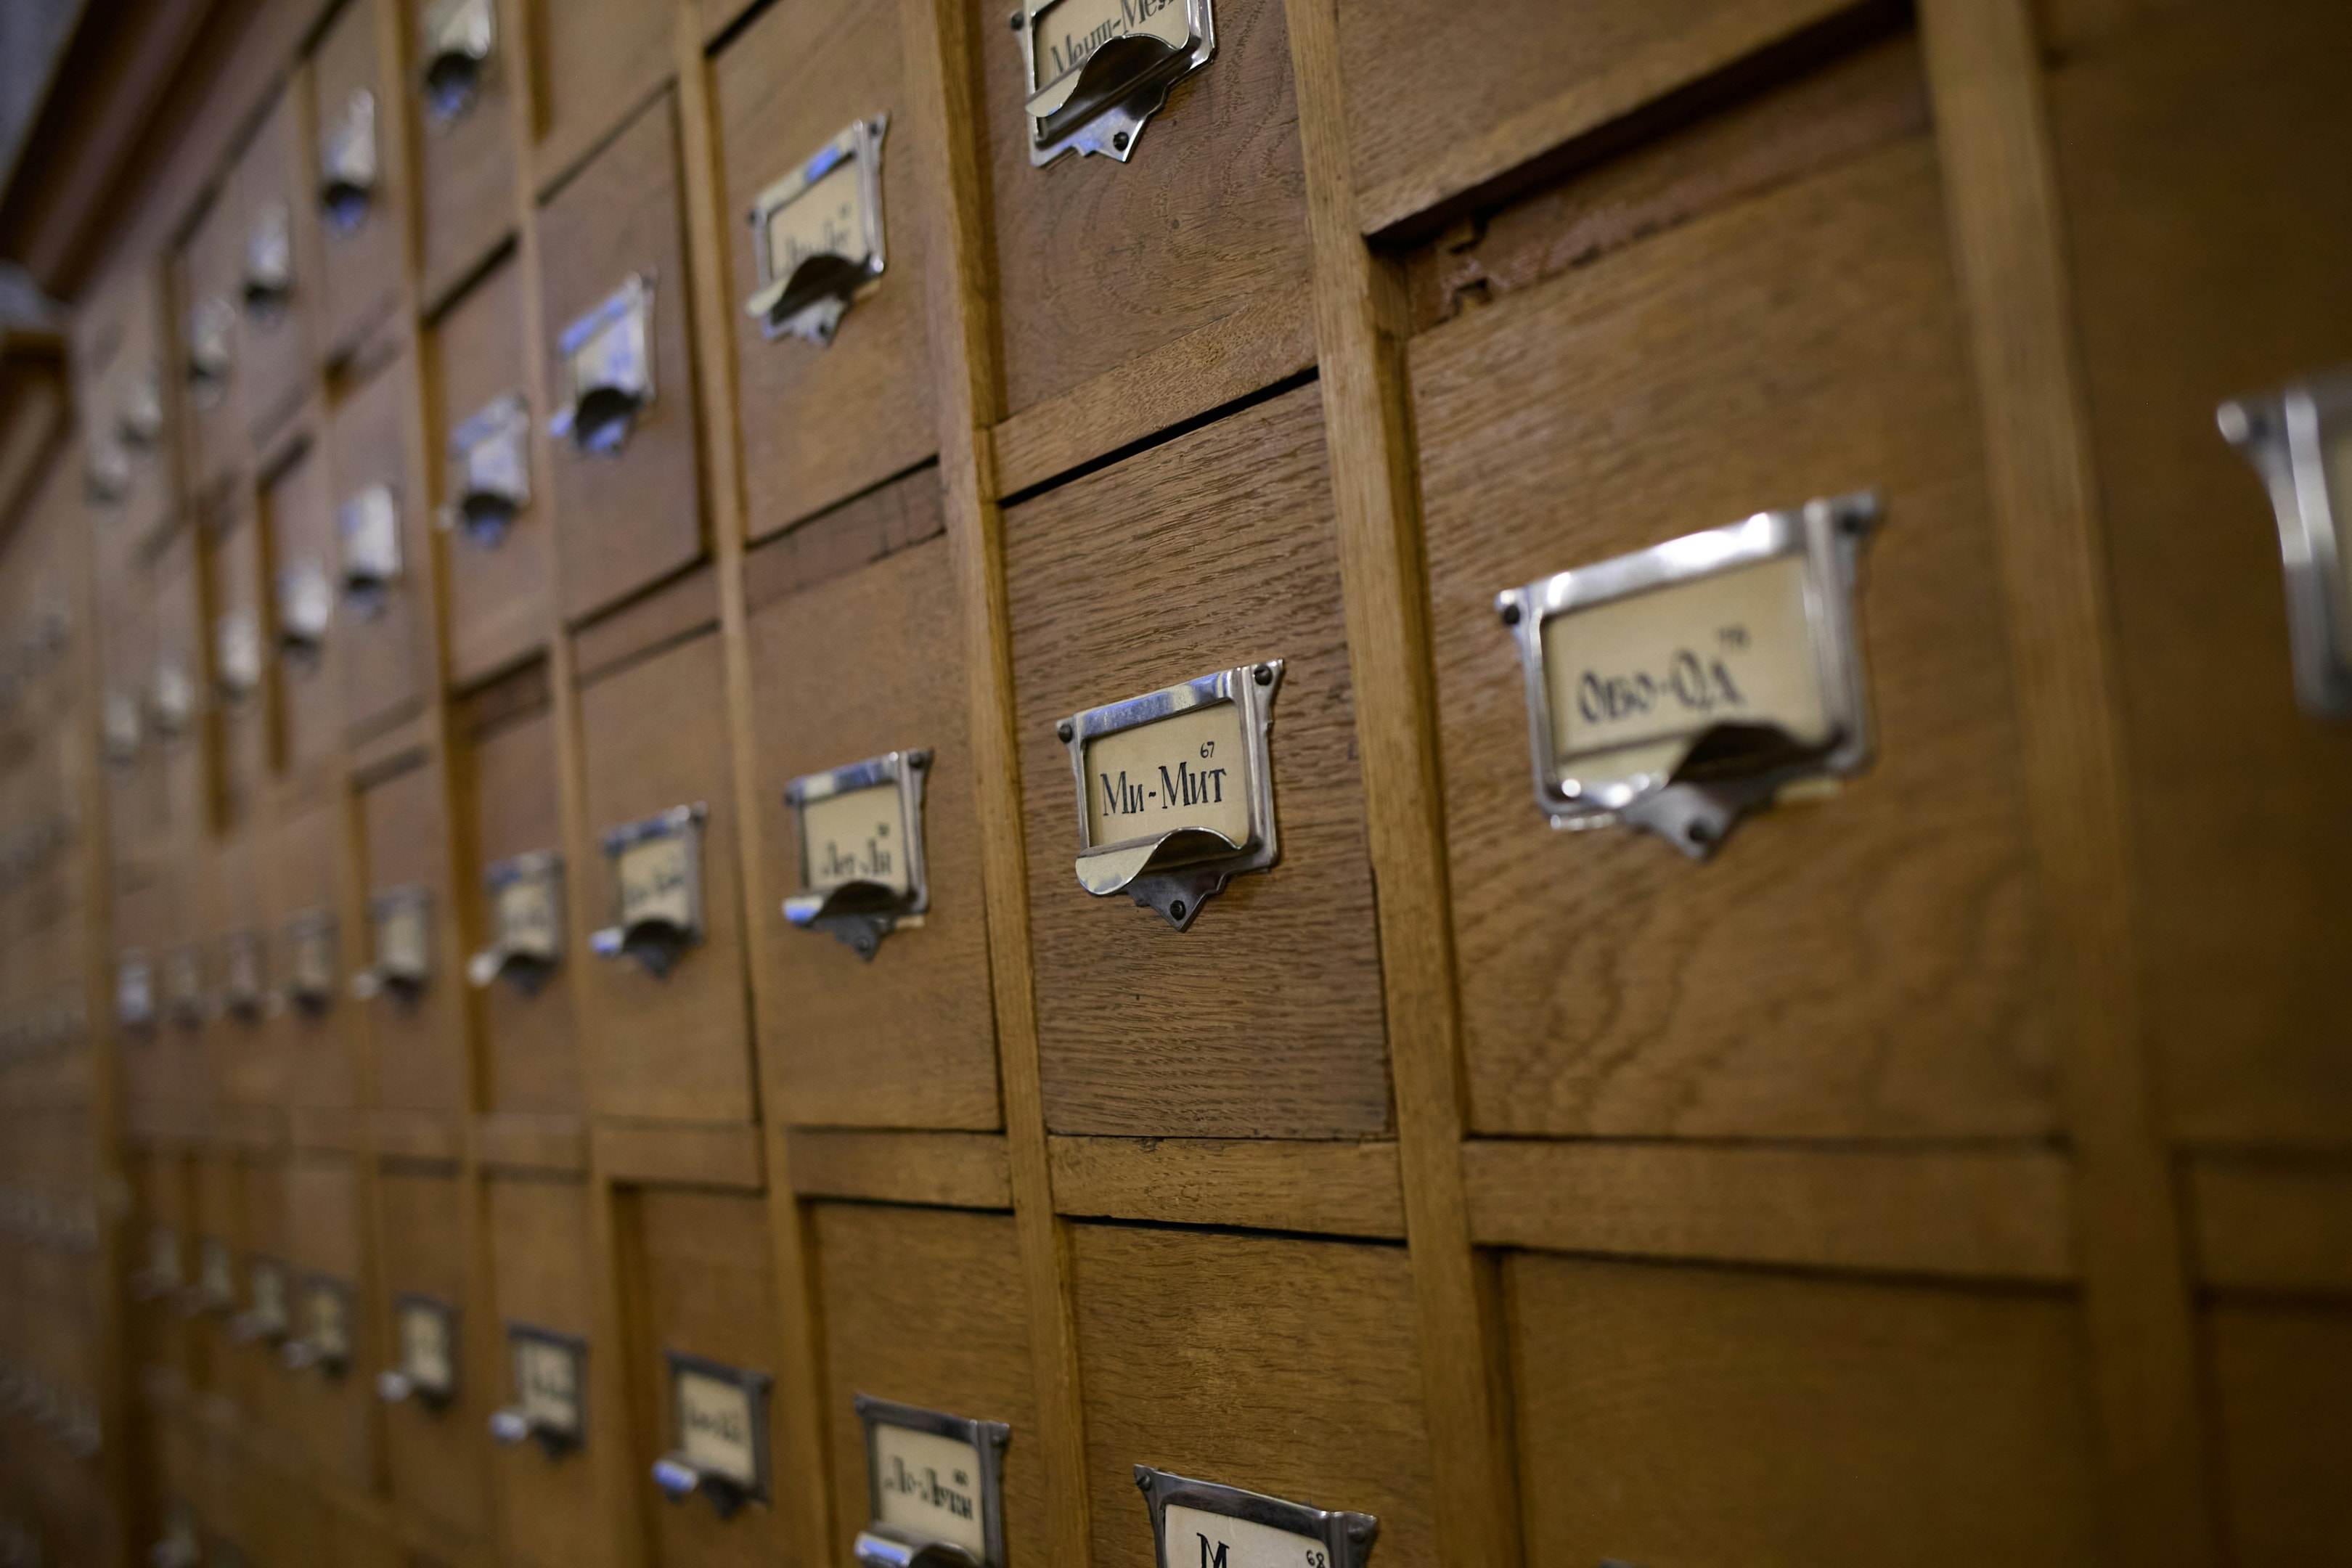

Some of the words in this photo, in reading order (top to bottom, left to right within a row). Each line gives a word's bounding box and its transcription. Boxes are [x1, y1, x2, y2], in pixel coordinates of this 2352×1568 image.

[1200, 741, 1214, 758] 67
[1101, 761, 1227, 816] Ми-Мит
[1307, 1550, 1325, 1568] 68
